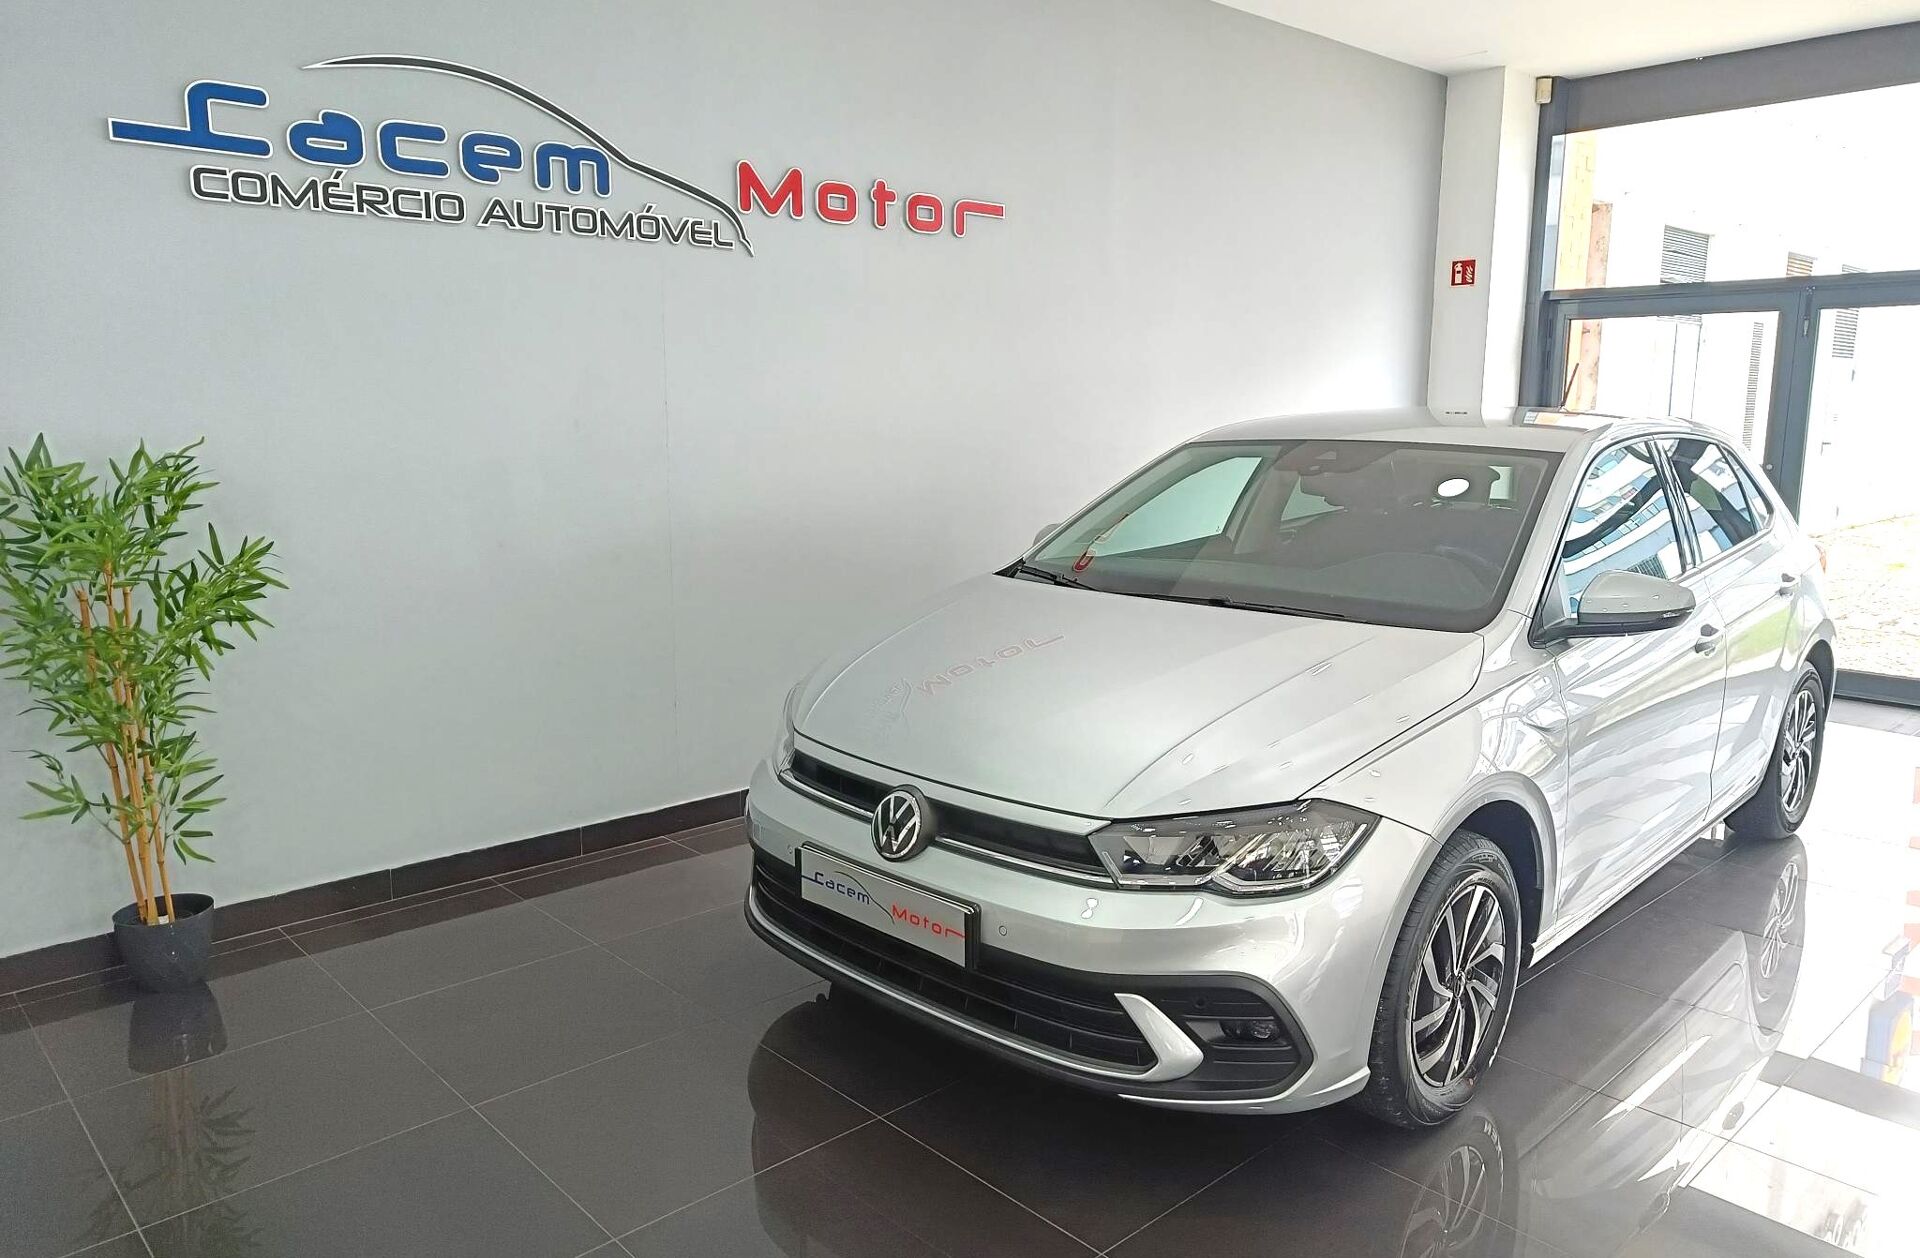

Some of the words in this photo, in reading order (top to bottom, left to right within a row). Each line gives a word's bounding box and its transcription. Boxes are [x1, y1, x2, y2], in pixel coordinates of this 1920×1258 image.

[189, 164, 466, 225] COMÉRCIO
[475, 196, 736, 250] AUTOMÓVEL
[736, 159, 1006, 238] Motor
[892, 904, 966, 938] Motor
